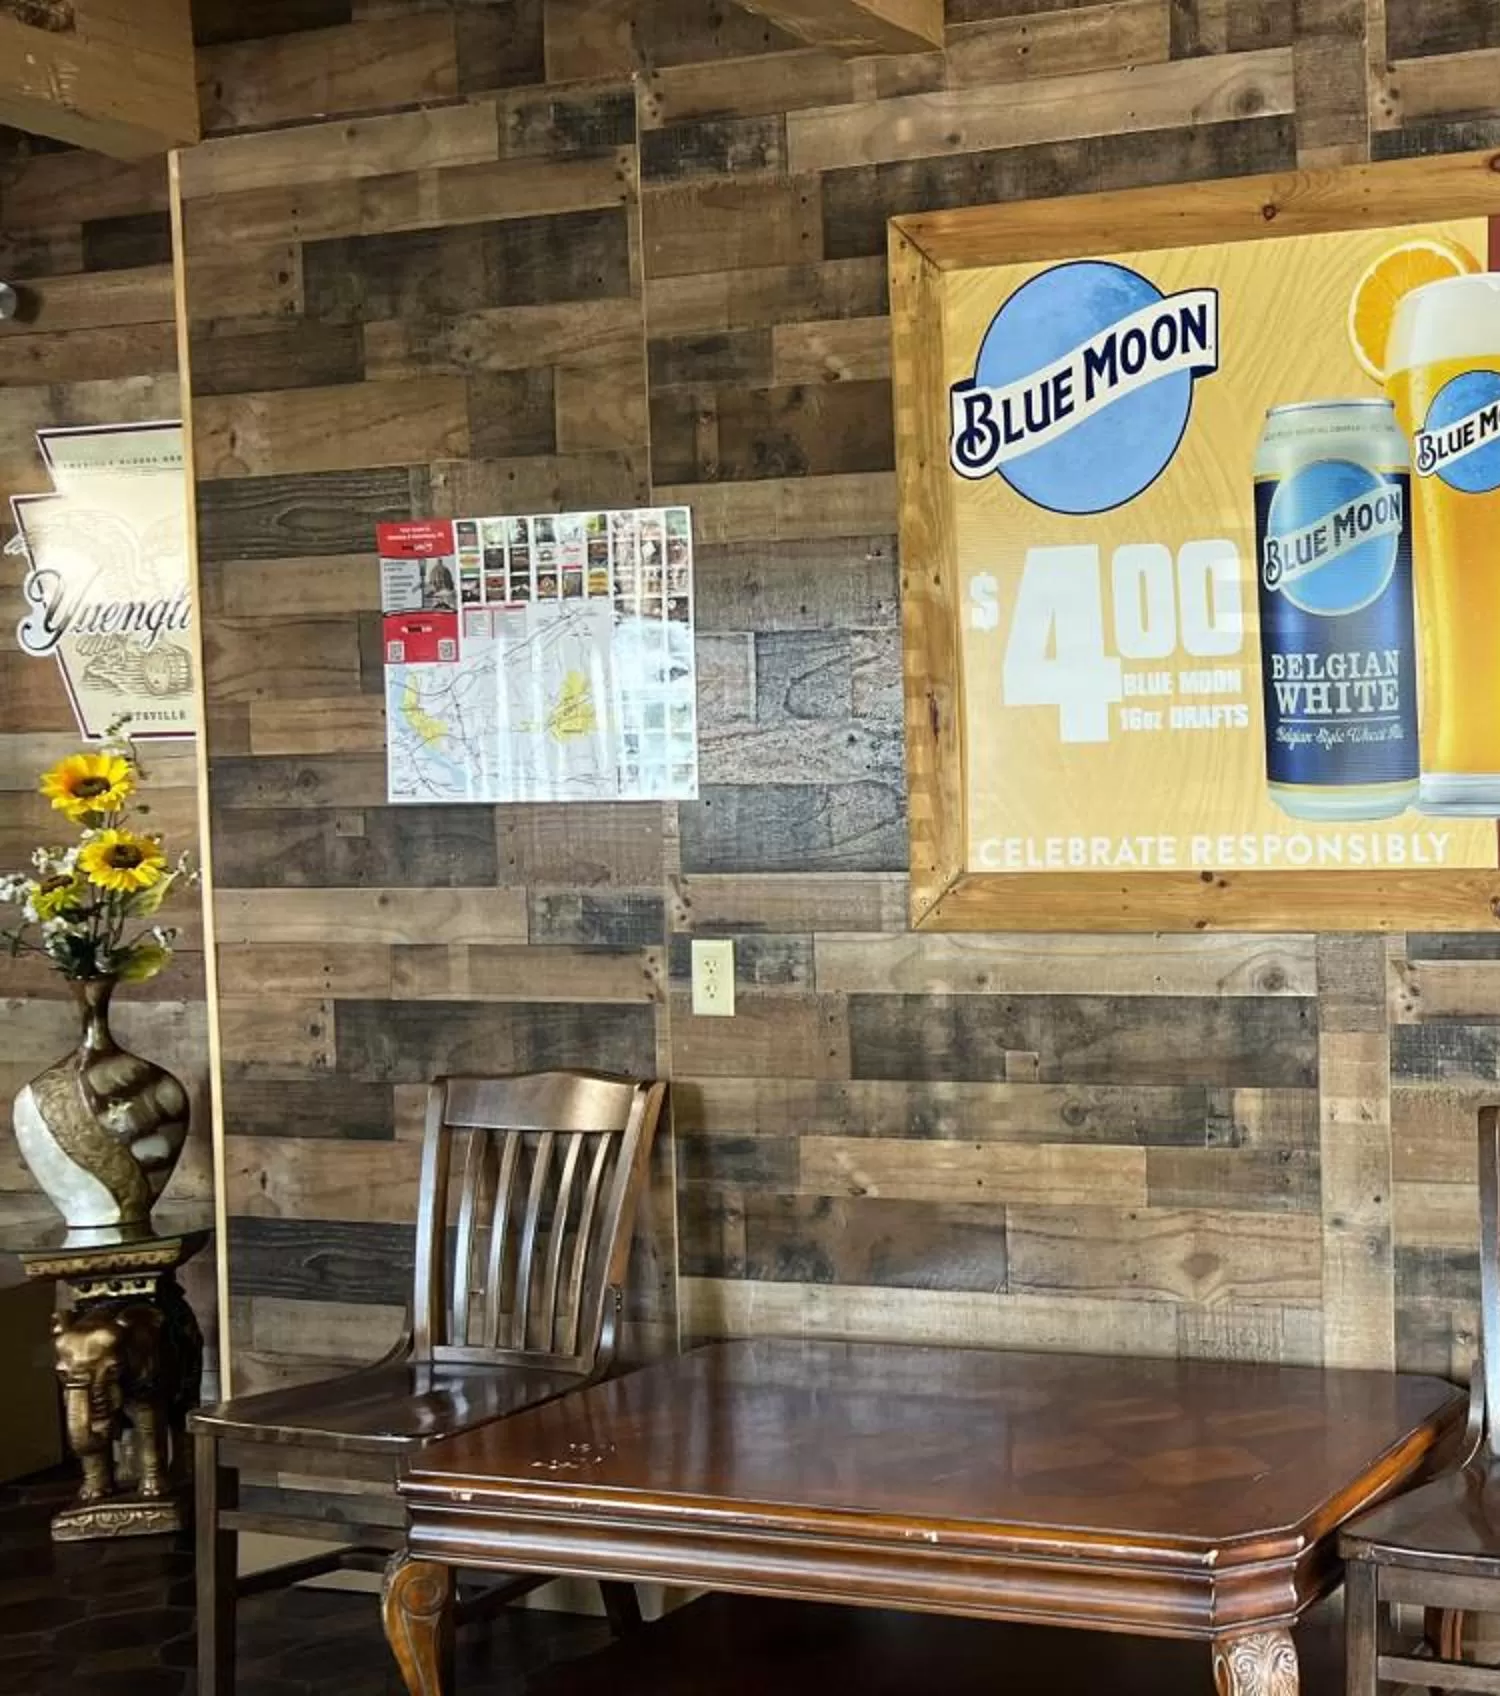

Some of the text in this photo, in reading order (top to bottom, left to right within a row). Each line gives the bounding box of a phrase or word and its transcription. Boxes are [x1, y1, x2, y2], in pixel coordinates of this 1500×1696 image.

[956, 303, 1208, 468] BLUE MOON
[1417, 420, 1475, 472] BLUE
[1265, 491, 1402, 586] BLUE MOON
[1123, 669, 1242, 696] BLUE MOON
[1271, 650, 1400, 680] BELGIAN
[1273, 678, 1400, 715] WHITE
[1169, 703, 1249, 729] DRAFTS
[979, 831, 1450, 868] CELEBRATE RESPONSIBLY
